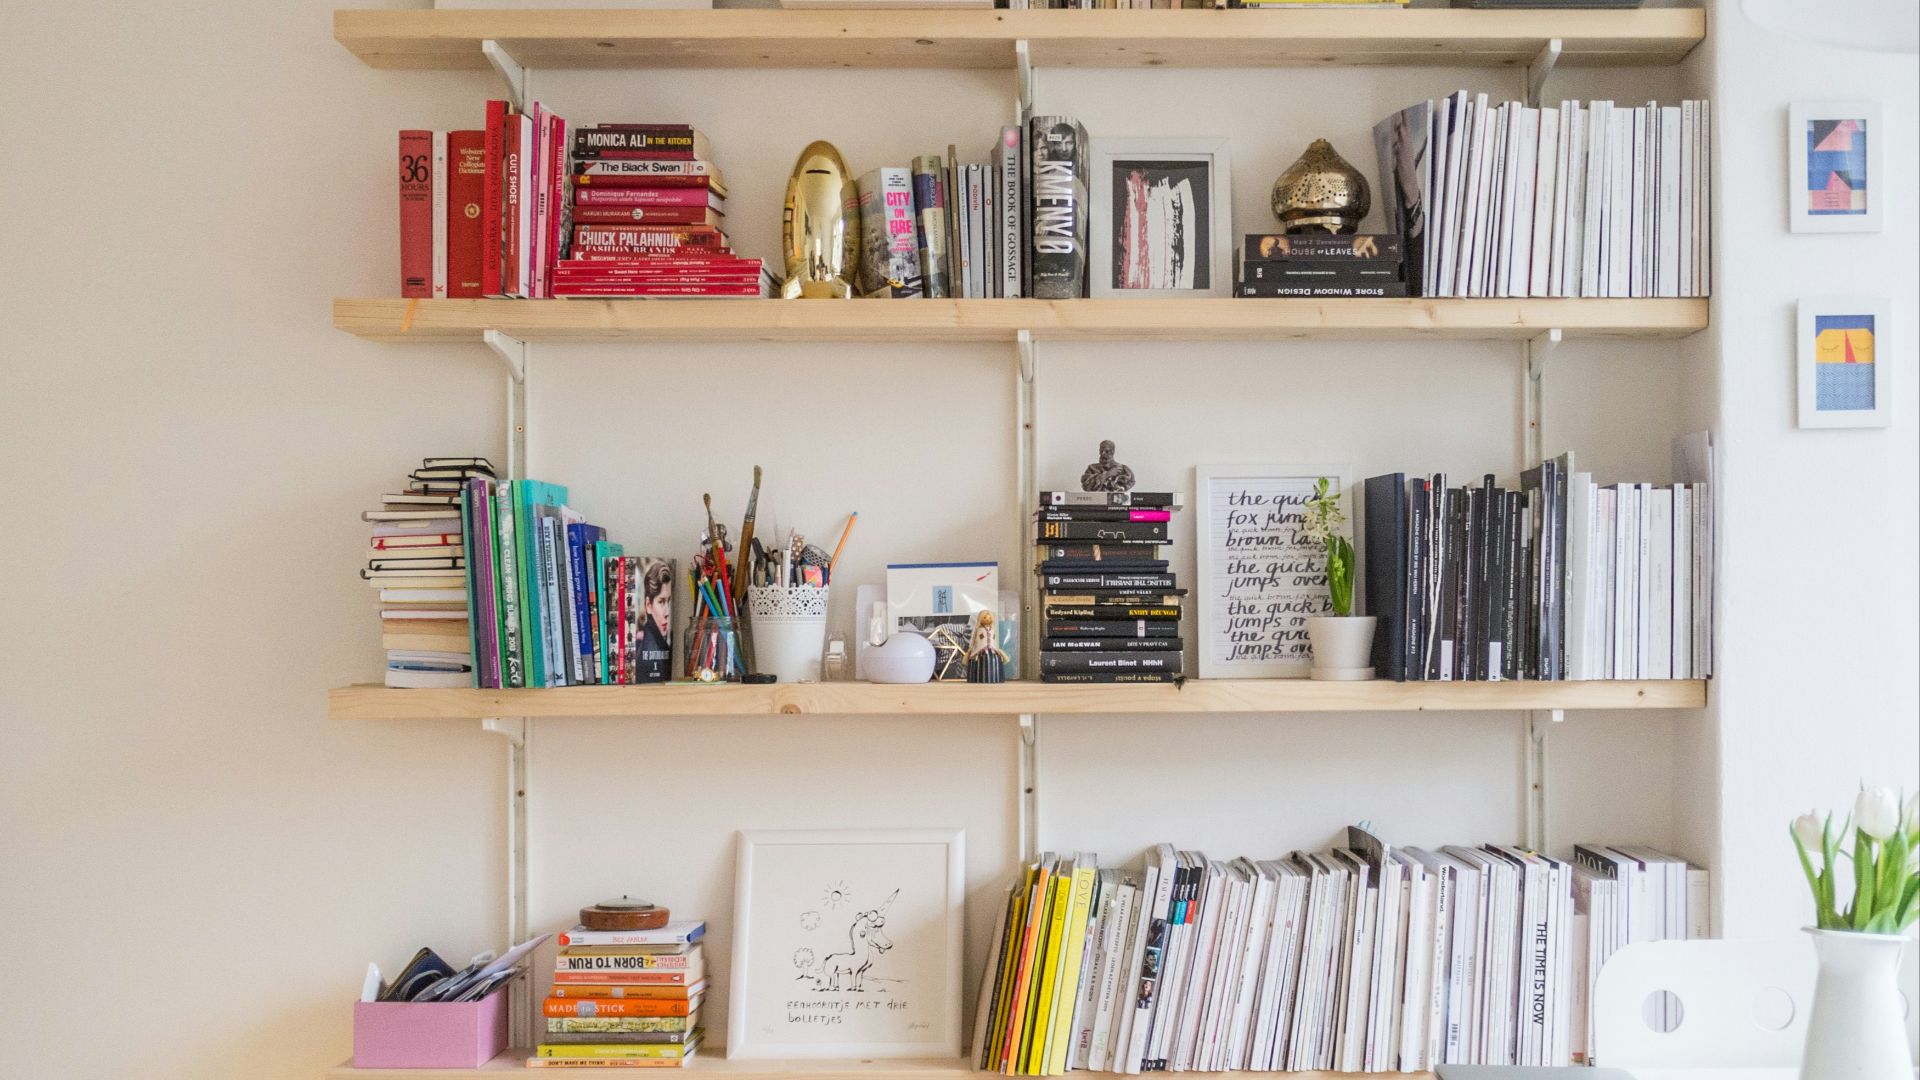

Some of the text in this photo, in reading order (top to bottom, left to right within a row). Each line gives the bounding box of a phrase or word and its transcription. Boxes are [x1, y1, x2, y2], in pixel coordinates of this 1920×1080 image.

[588, 134, 646, 147] MONICA ALI
[401, 155, 429, 183] 36
[600, 162, 680, 172] The Black Swan
[509, 153, 517, 205] CULT SHOES
[591, 190, 624, 198] Dominique
[886, 192, 910, 206] CITY
[894, 208, 905, 218] ON
[1007, 155, 1017, 282] THE BOOK OF GOSSAGE
[889, 219, 912, 234] FIRE
[579, 231, 681, 247] CHUCK PALAHNIUK
[585, 245, 675, 254] FASHION BRANDS
[1277, 288, 1384, 296] STORE WINDOW DESIGN
[1228, 490, 1270, 506] the
[1227, 510, 1258, 528] fox
[573, 558, 581, 577] brands
[1227, 558, 1321, 581] the quick
[505, 576, 514, 603] SPRING
[1222, 576, 1281, 598] jumps
[507, 604, 515, 635] SUMMER
[1227, 600, 1261, 615] the
[1266, 600, 1317, 623] quick
[1224, 616, 1282, 634] jumps
[509, 636, 517, 651] 2013
[1231, 630, 1265, 642] the
[1226, 643, 1284, 660] jumps
[508, 657, 518, 684] Kate
[1075, 871, 1091, 909] LOVE
[1439, 867, 1447, 912] Wonderland
[569, 957, 593, 969] RUN
[596, 957, 611, 969] TO
[615, 957, 644, 969] BORN
[1533, 921, 1547, 1025] THE TIME IS NOW
[549, 1005, 578, 1013] MADE
[594, 1005, 625, 1013] STICK
[856, 1001, 881, 1009] MET
